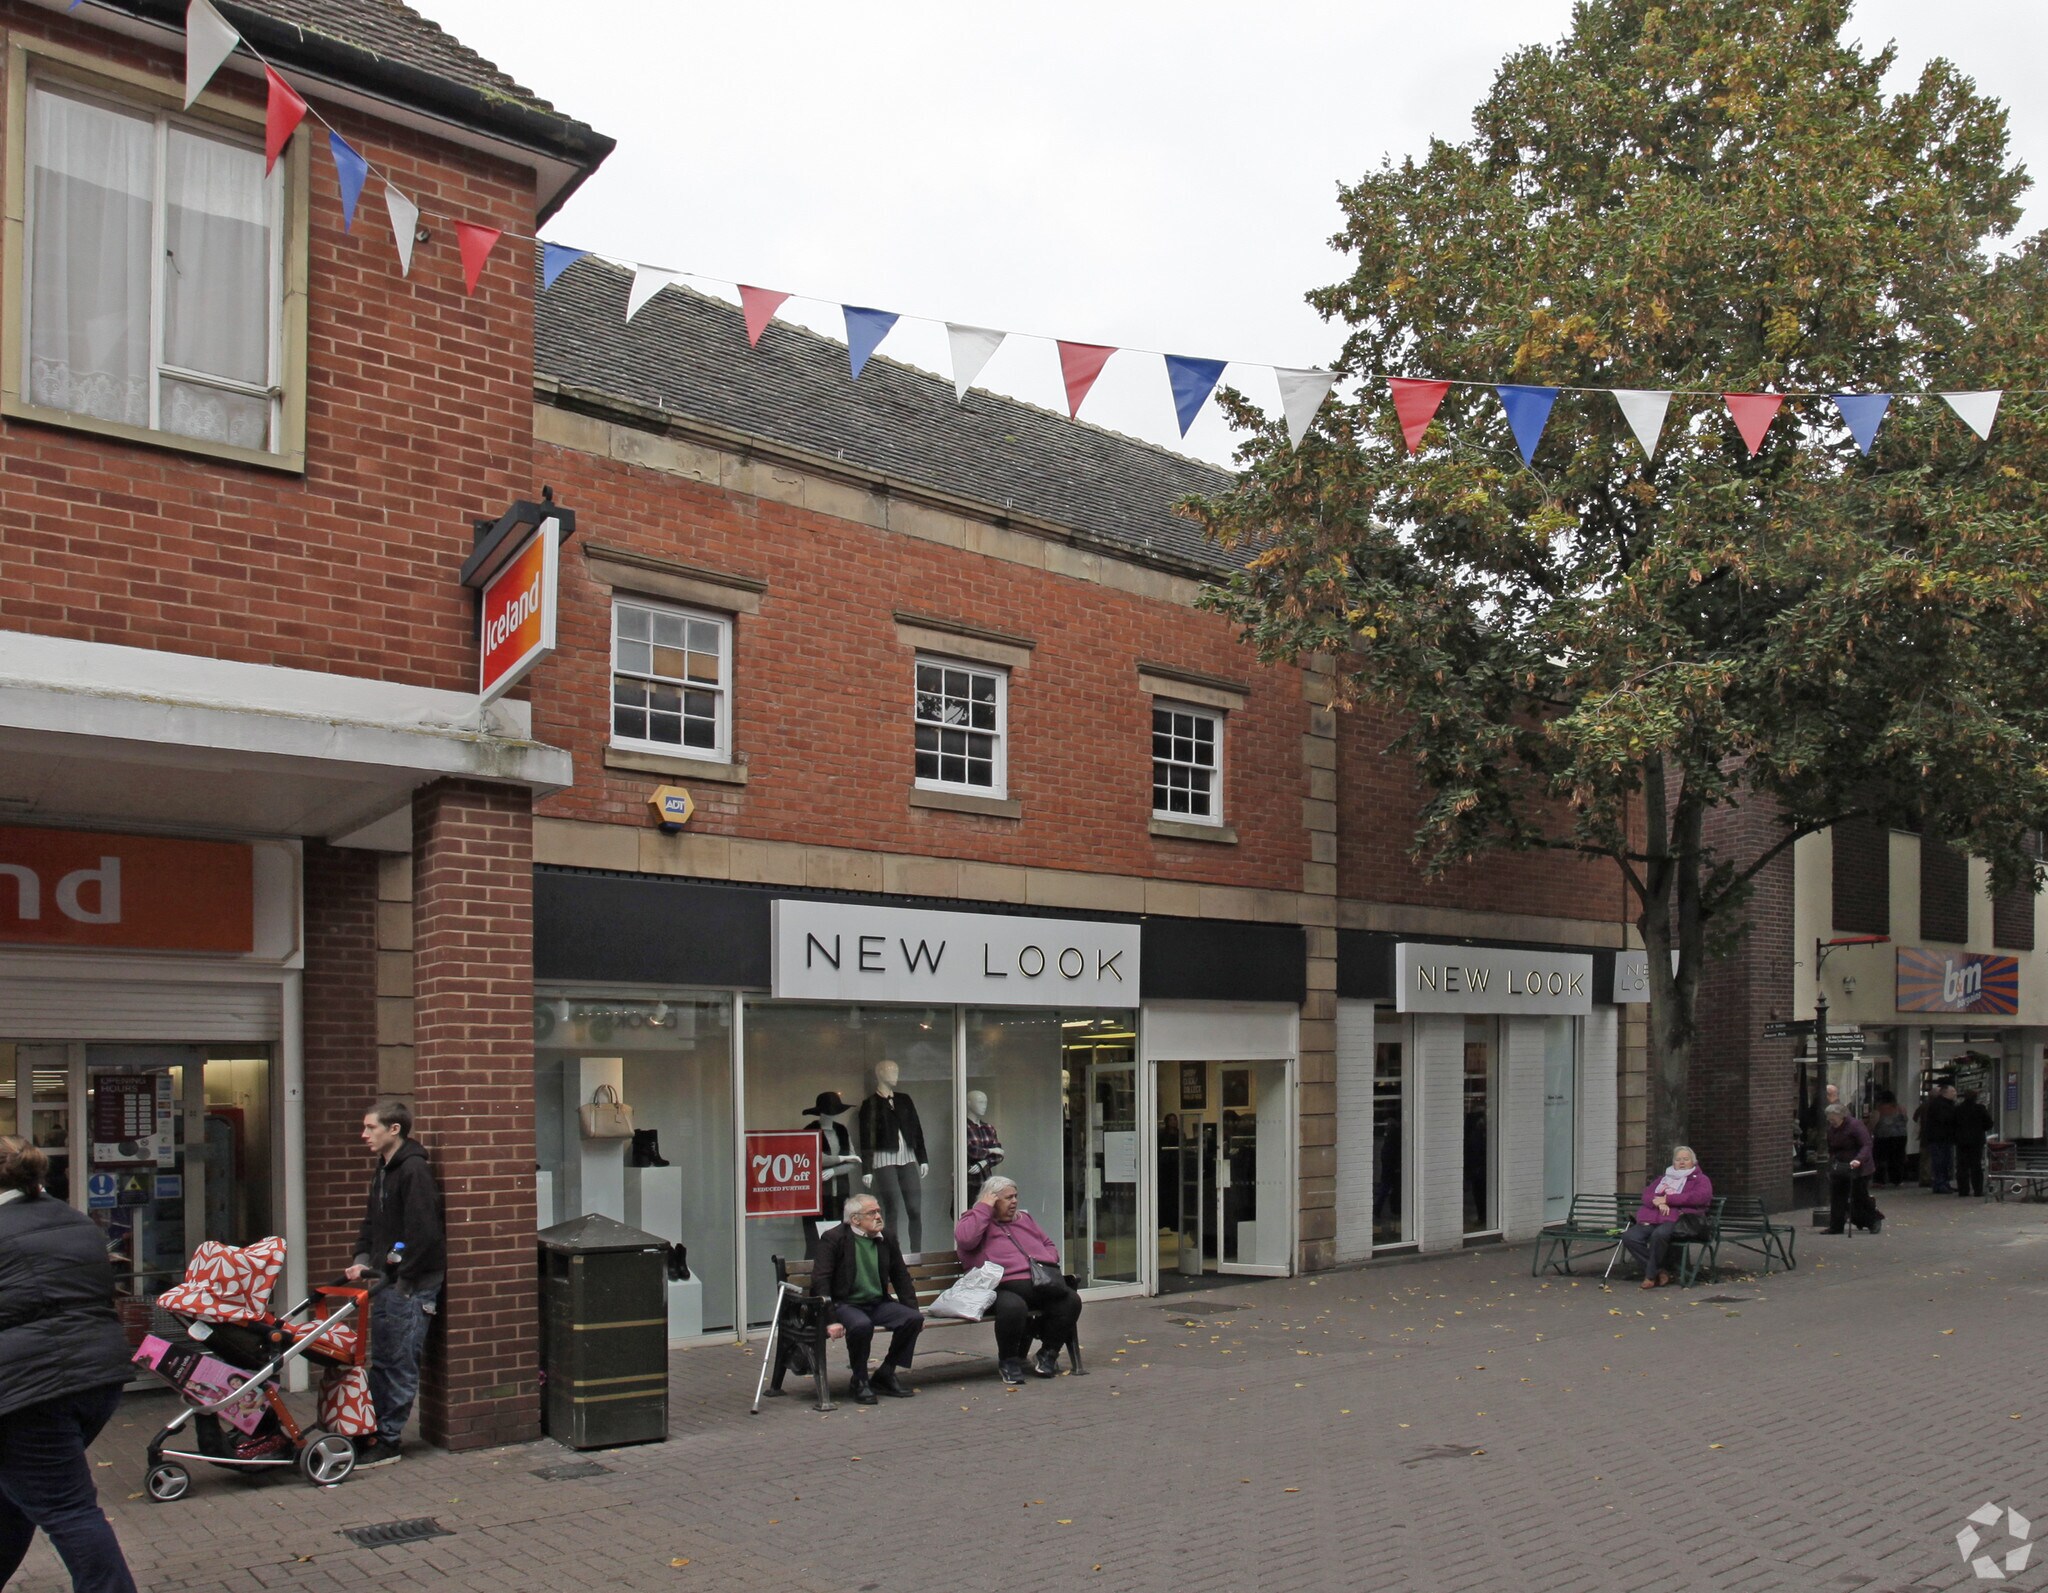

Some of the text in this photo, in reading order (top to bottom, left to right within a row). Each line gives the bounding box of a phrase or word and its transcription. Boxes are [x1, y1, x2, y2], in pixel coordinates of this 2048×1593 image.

[486, 571, 540, 656] Iceland
[666, 799, 685, 810] ADT
[806, 932, 1123, 981] NEW LOOK
[1417, 965, 1584, 996] NEW LOOK
[1627, 963, 1649, 976] NE
[1621, 979, 1645, 991] LO
[101, 1077, 146, 1085] OPENING
[752, 1153, 810, 1184] 70% off
